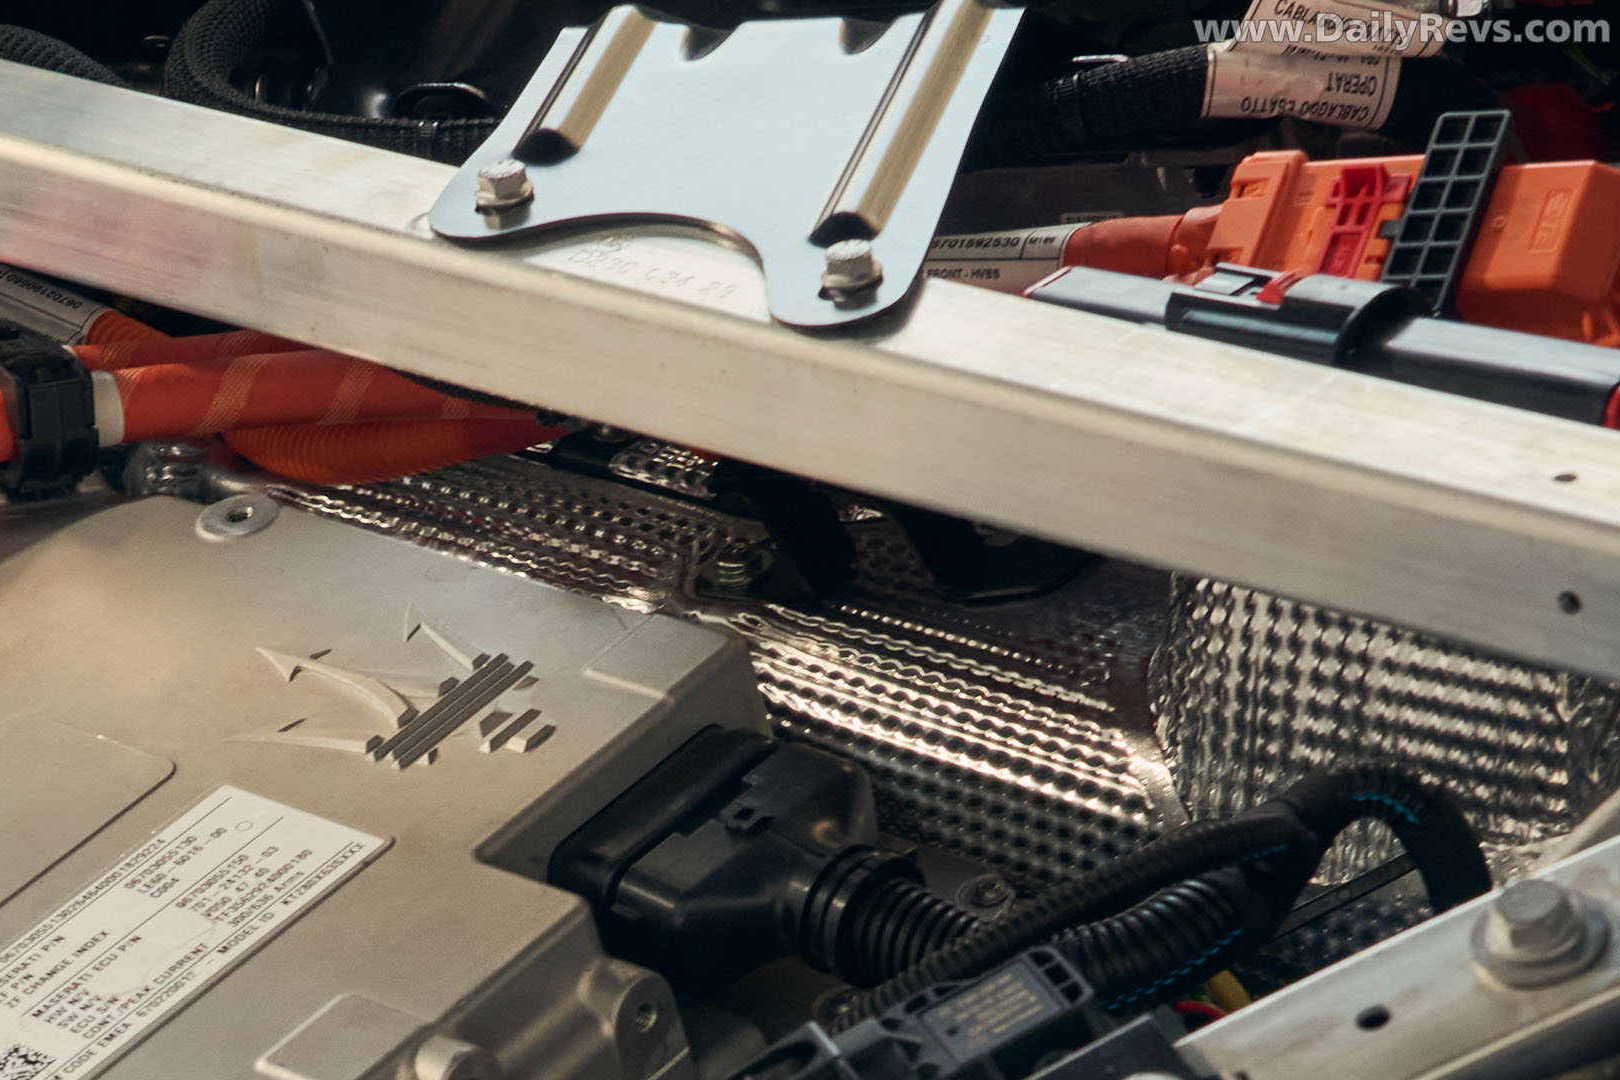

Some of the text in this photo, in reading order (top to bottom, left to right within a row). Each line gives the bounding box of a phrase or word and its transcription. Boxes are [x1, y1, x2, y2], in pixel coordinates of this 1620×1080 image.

[1325, 72, 1378, 96] OPERAT
[40, 935, 66, 952] P/N
[4, 930, 109, 1008] ZF CHANGE INDEX
[30, 935, 142, 1018] MASERATI ECU P/N
[152, 942, 208, 984] CURRENT
[9, 972, 35, 989] P/N
[62, 1048, 97, 1073] CODE
[96, 1022, 132, 1047] EMEA
[215, 925, 260, 954] MODEL
[257, 908, 276, 923] ID
[43, 1006, 67, 1023] HW
[55, 1012, 79, 1028] SW
[68, 995, 120, 1033] ECU S/N
